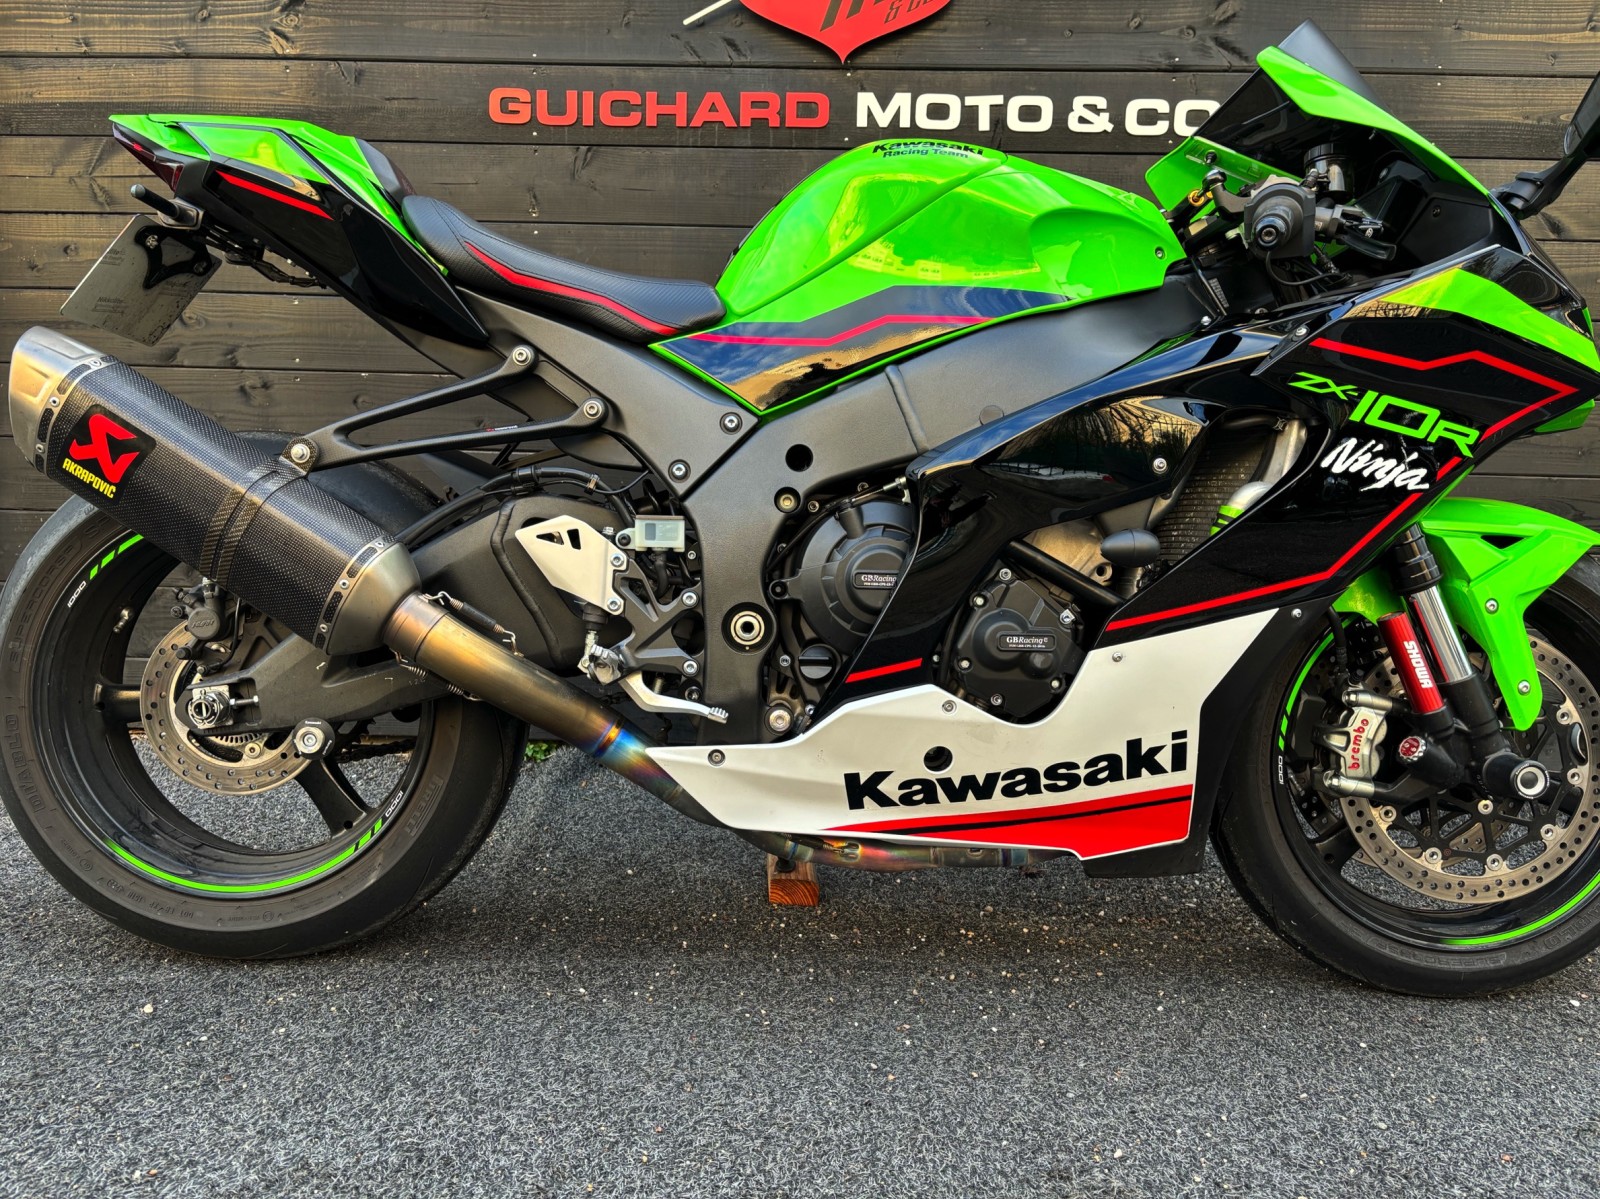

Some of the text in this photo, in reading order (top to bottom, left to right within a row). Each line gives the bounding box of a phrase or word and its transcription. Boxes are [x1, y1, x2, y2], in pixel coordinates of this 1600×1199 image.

[488, 87, 1221, 137] GUICHARD MOTO & CO
[872, 141, 984, 156] Kawasaki
[882, 148, 969, 159] Racing Team
[1288, 371, 1480, 458] ZX-10R
[1320, 437, 1430, 492] Ninja
[67, 580, 87, 608] 1000
[861, 574, 897, 585] GBRacing
[1403, 640, 1434, 689] SHOWA
[5, 713, 46, 814] DIABLO
[1347, 718, 1370, 771] brembo
[844, 729, 1188, 811] Kawasaki
[1277, 755, 1285, 785] 1000
[385, 790, 404, 818] 1000
[403, 774, 445, 837] PIRELLI
